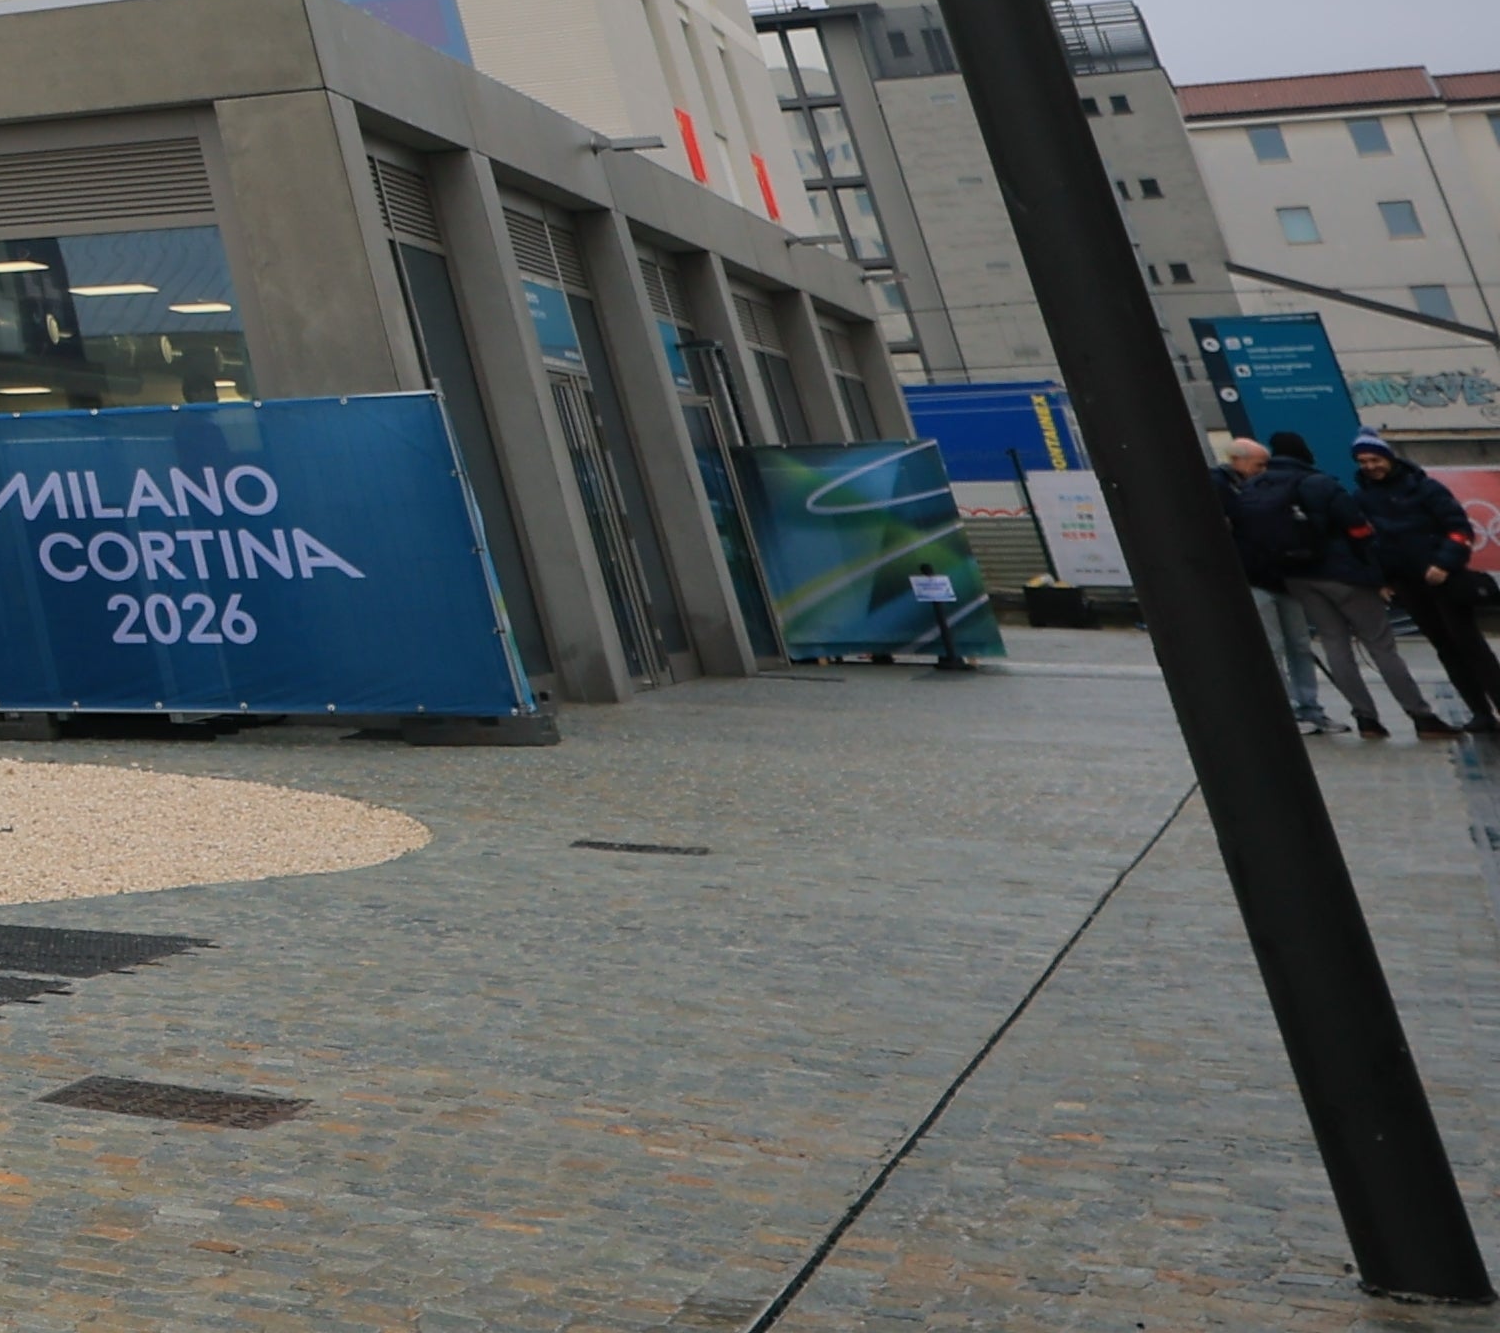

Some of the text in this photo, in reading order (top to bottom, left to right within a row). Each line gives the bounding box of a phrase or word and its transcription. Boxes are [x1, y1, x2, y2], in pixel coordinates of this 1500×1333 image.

[1031, 394, 1068, 472] ONTAINEX
[39, 528, 366, 582] CORTINA
[107, 593, 258, 645] 2026
